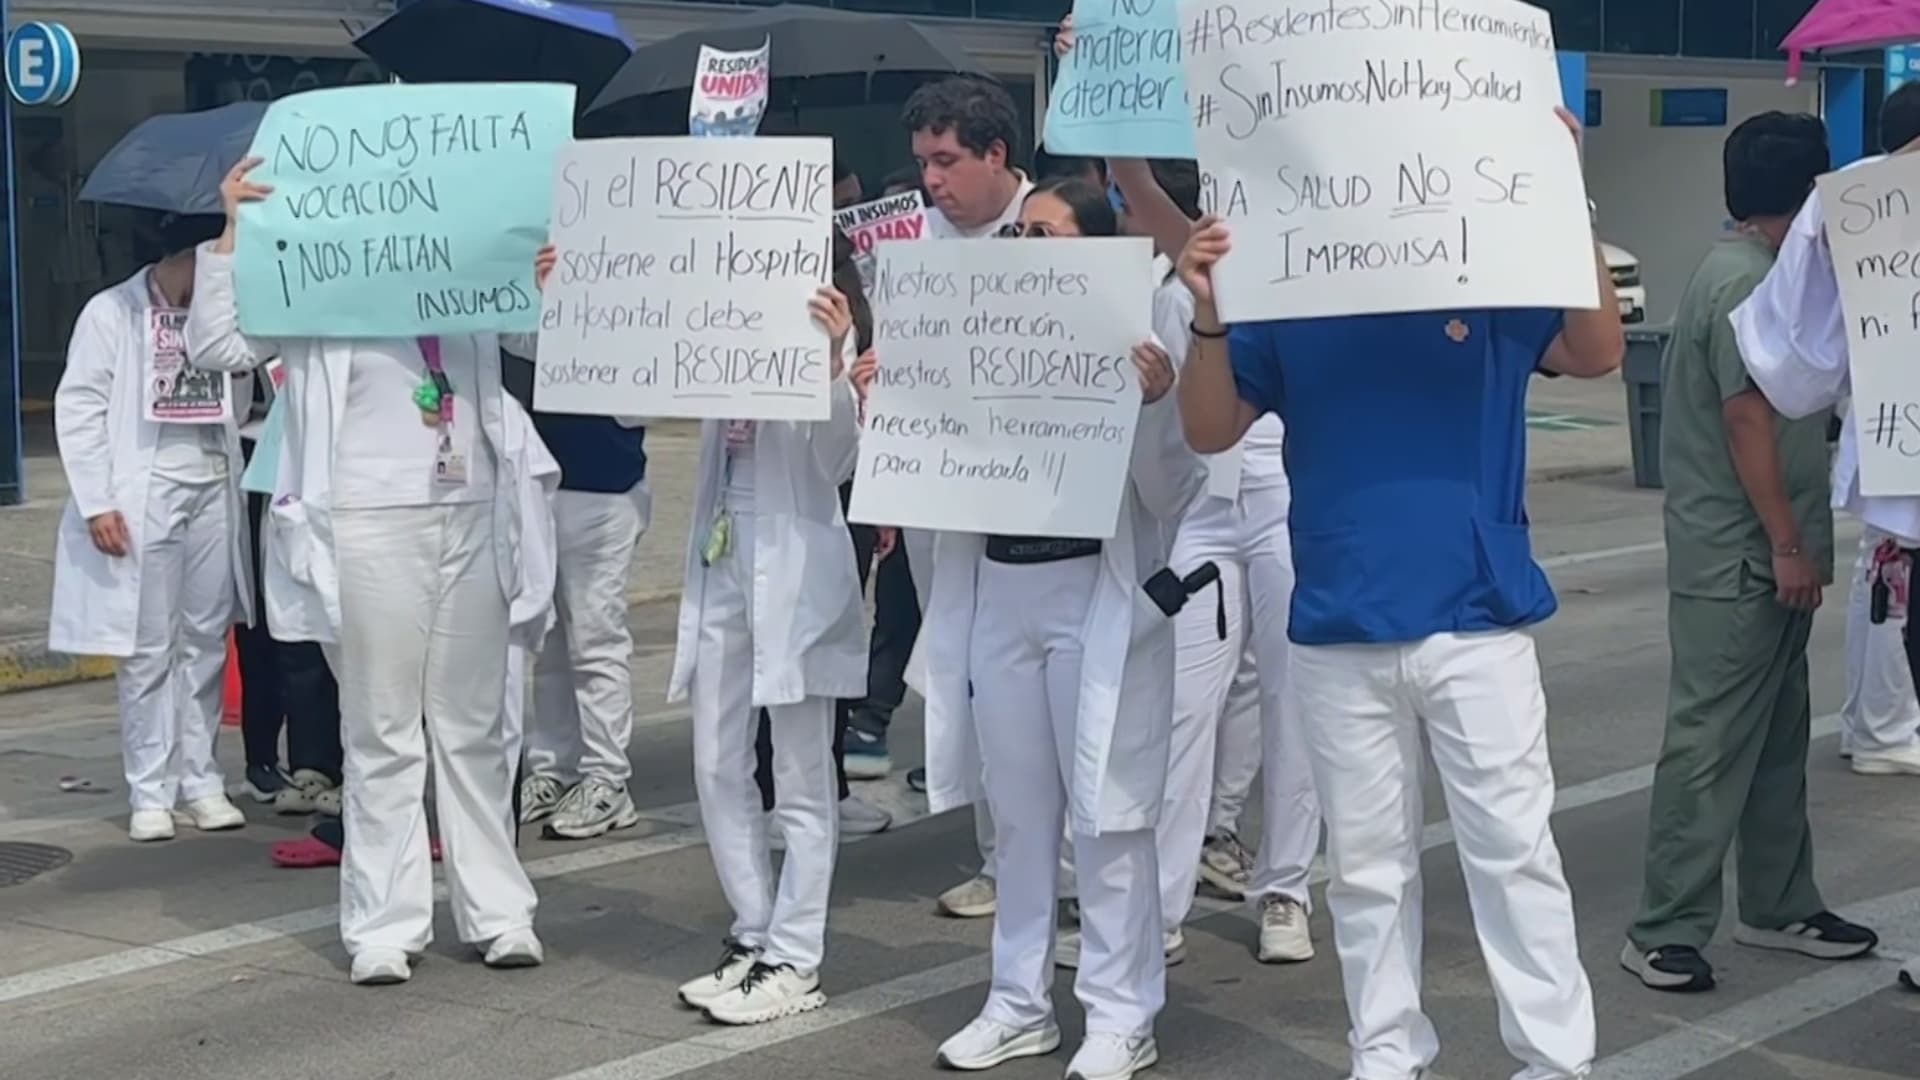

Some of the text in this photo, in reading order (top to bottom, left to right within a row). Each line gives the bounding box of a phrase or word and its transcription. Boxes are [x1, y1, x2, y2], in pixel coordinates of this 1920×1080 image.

[20, 39, 44, 87] E
[1073, 25, 1181, 72] material
[1060, 73, 1175, 119] atender
[1194, 57, 1523, 140] #SinInsumosNoHaySalud
[273, 111, 532, 175] NO NOS FALTA
[285, 171, 439, 219] VOCACIÓN
[607, 156, 636, 209] el
[655, 157, 831, 217] RESIDENTE
[857, 193, 919, 223] INSUMOS
[1276, 165, 1372, 217] SALUD
[1399, 152, 1451, 205] NO
[1474, 156, 1535, 206] SE
[876, 213, 924, 241] HAY
[1840, 183, 1910, 235] Sin
[362, 233, 453, 278] FALTAN
[561, 230, 830, 285] sostiene al Hospital
[415, 278, 532, 322] INSUMOS
[969, 267, 1090, 308] pacientes
[541, 290, 765, 340] el Hospital debe
[539, 338, 823, 390] sostener al RESIDENTE
[968, 346, 1128, 394] RESIDENTES
[870, 406, 1127, 445] necesitan herramientas
[871, 451, 922, 479] para
